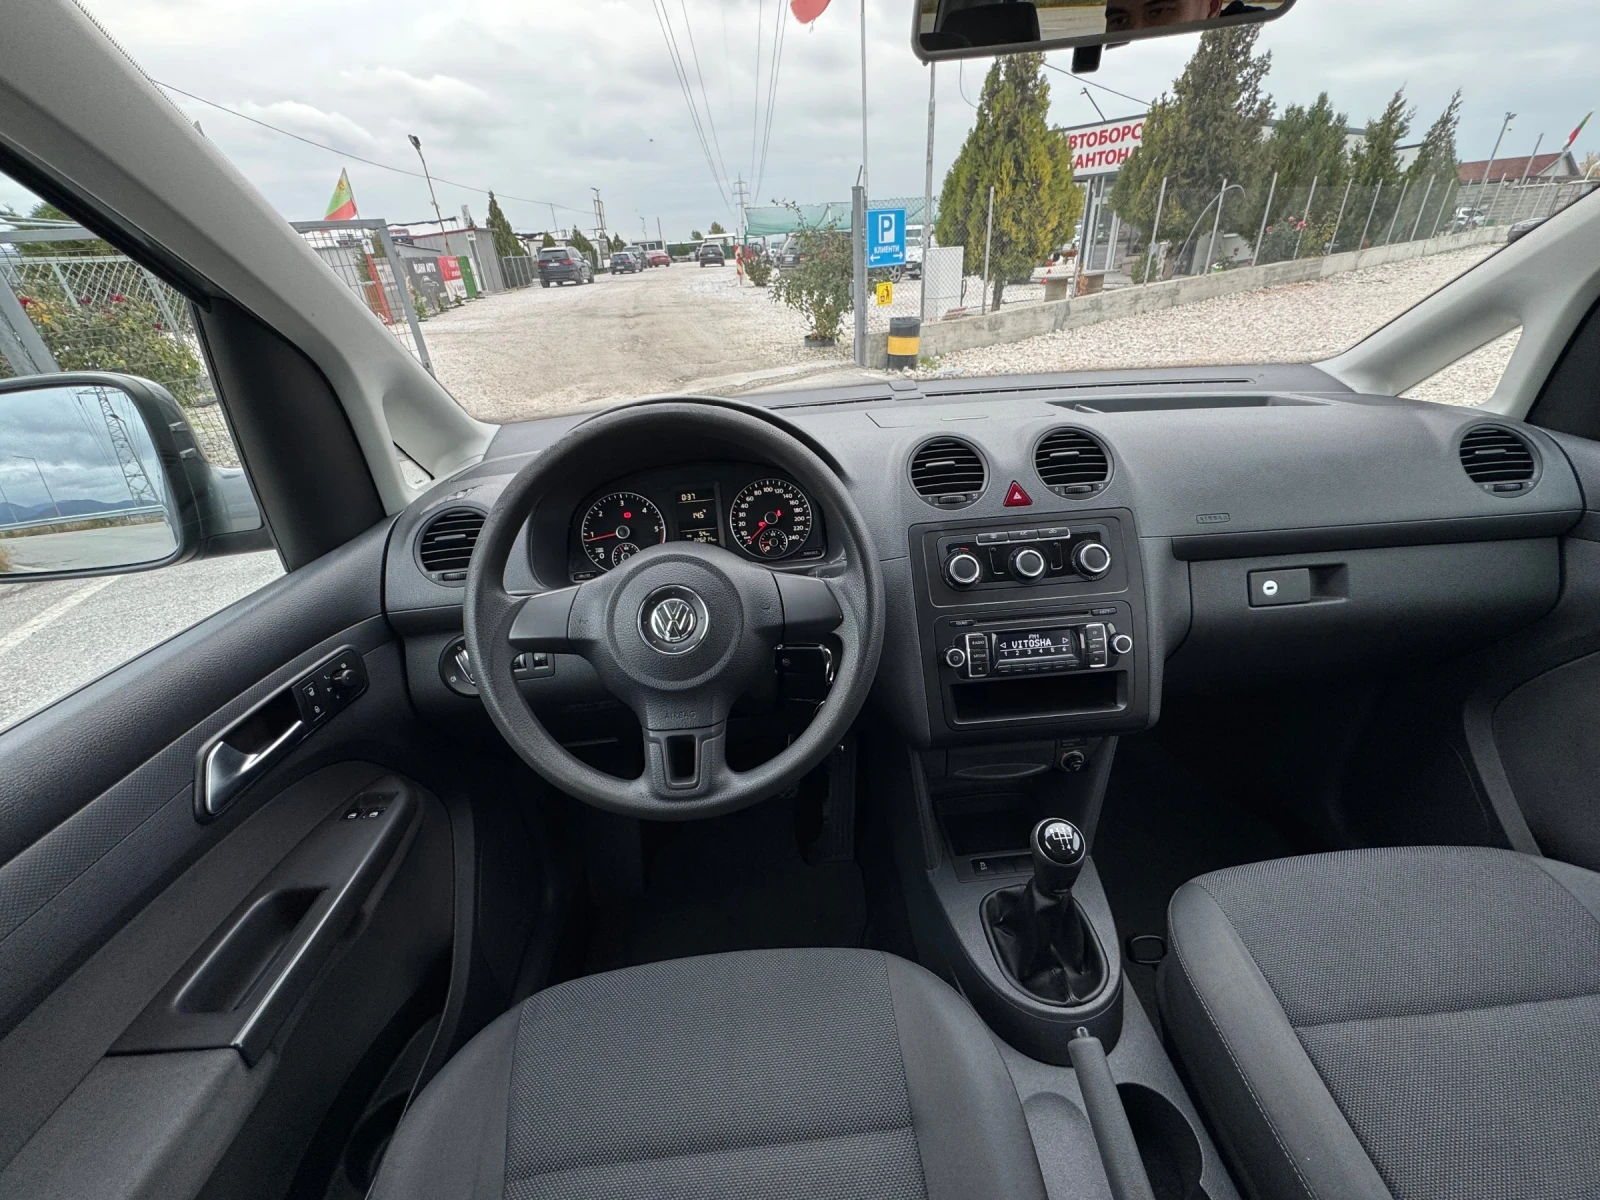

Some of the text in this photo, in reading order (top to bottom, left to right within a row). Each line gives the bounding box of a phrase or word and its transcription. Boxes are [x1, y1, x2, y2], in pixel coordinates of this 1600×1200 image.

[1068, 122, 1143, 151] ВТОБОРС
[881, 215, 893, 242] P
[874, 245, 900, 254] КЛИЕНТИ
[1011, 637, 1052, 649] VITOSHA
